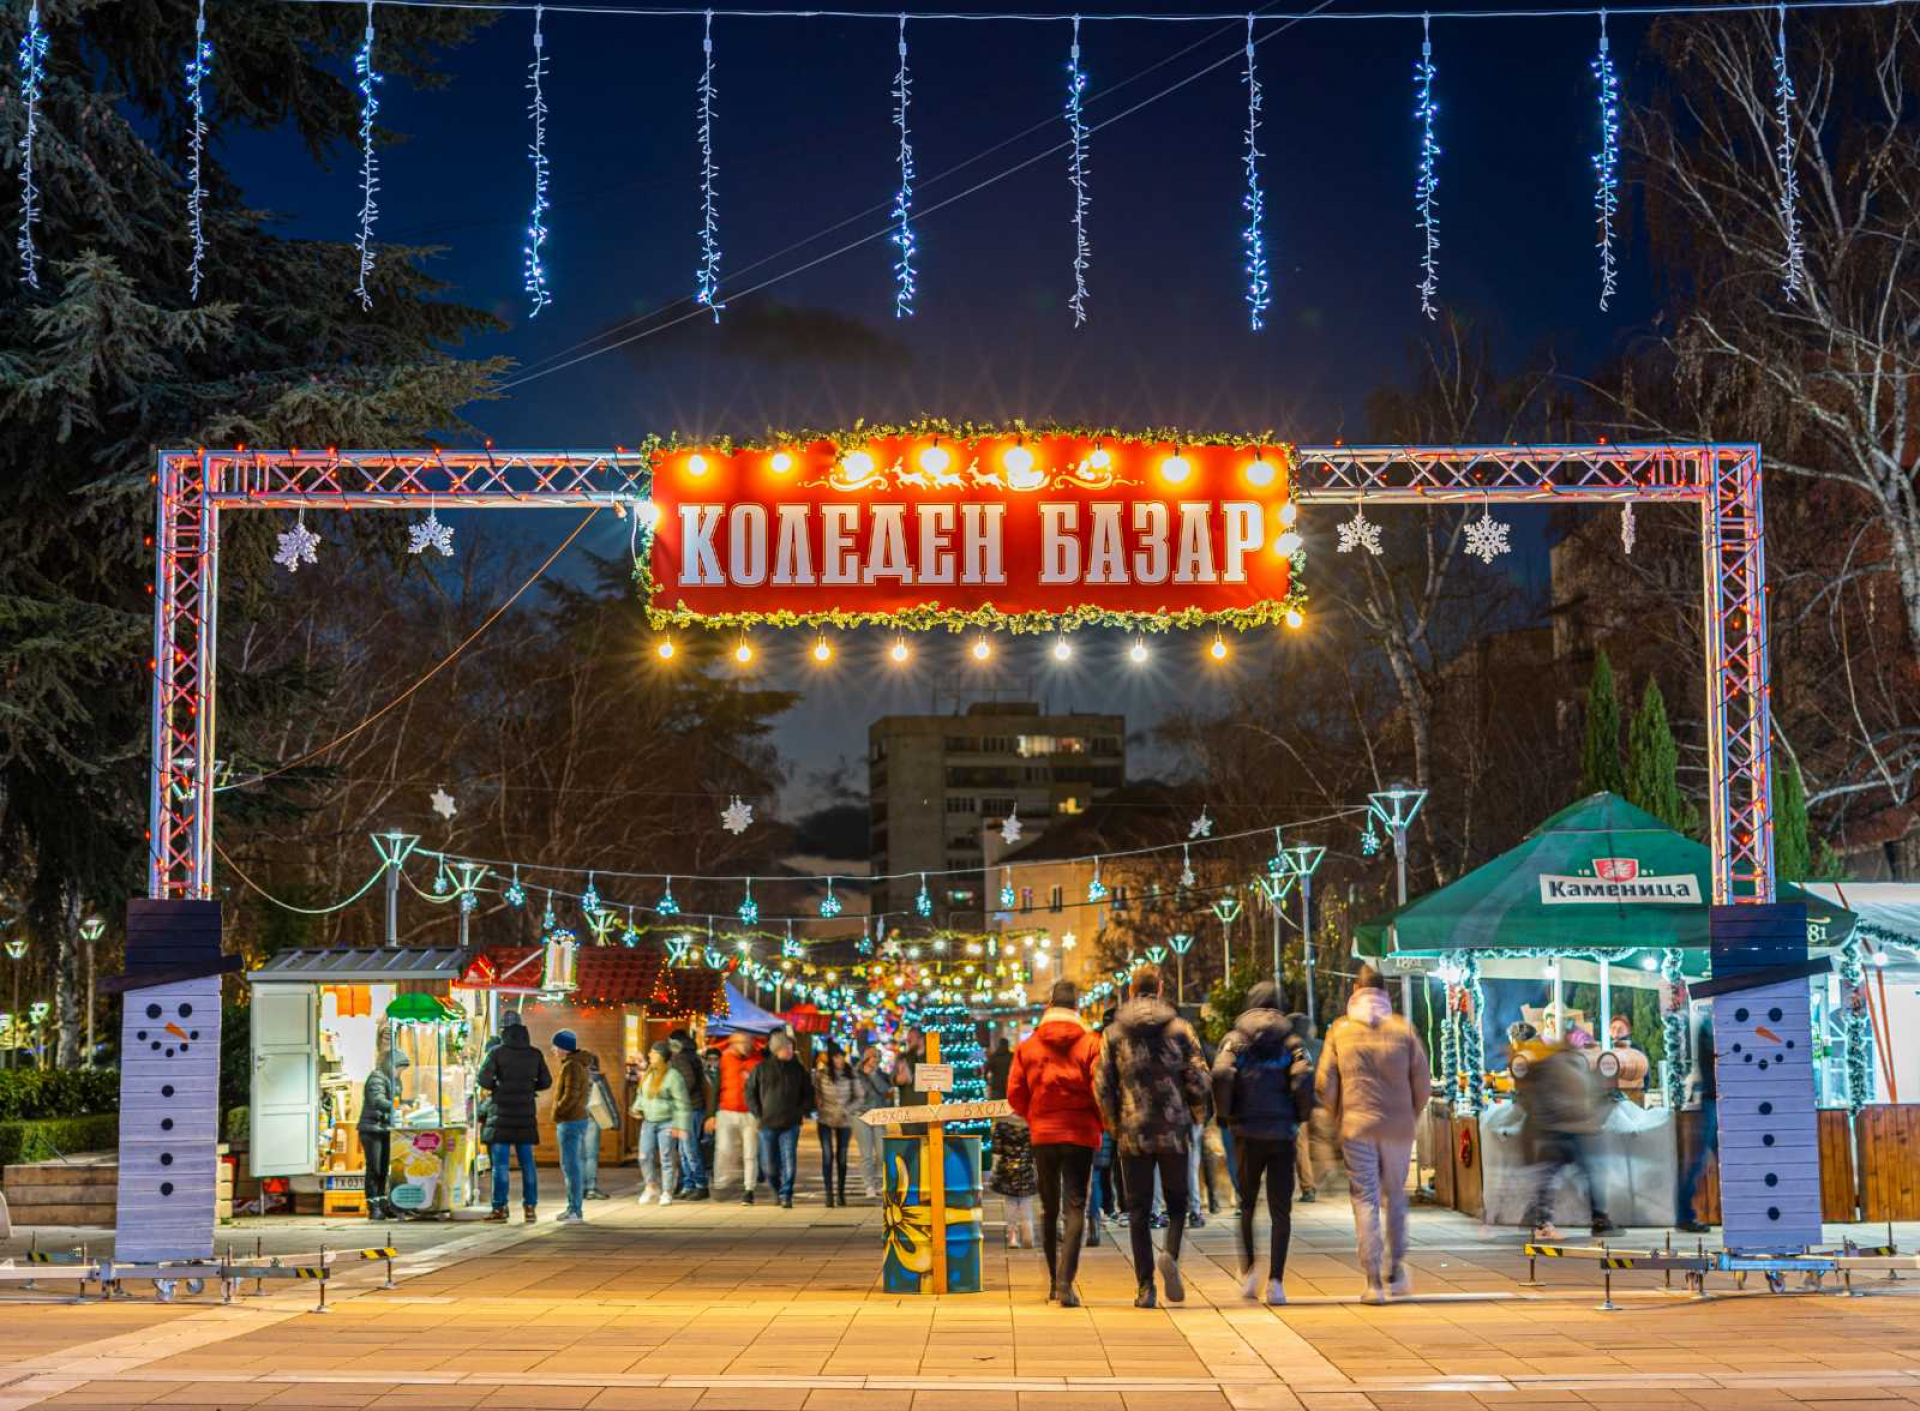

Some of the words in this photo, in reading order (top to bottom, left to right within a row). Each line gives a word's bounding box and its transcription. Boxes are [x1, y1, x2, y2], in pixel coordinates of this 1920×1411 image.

[677, 501, 1008, 586] КОЛЕДЕН
[1038, 500, 1265, 585] БАЗАР
[1549, 880, 1690, 897] Каменица
[1806, 924, 1827, 943] 81
